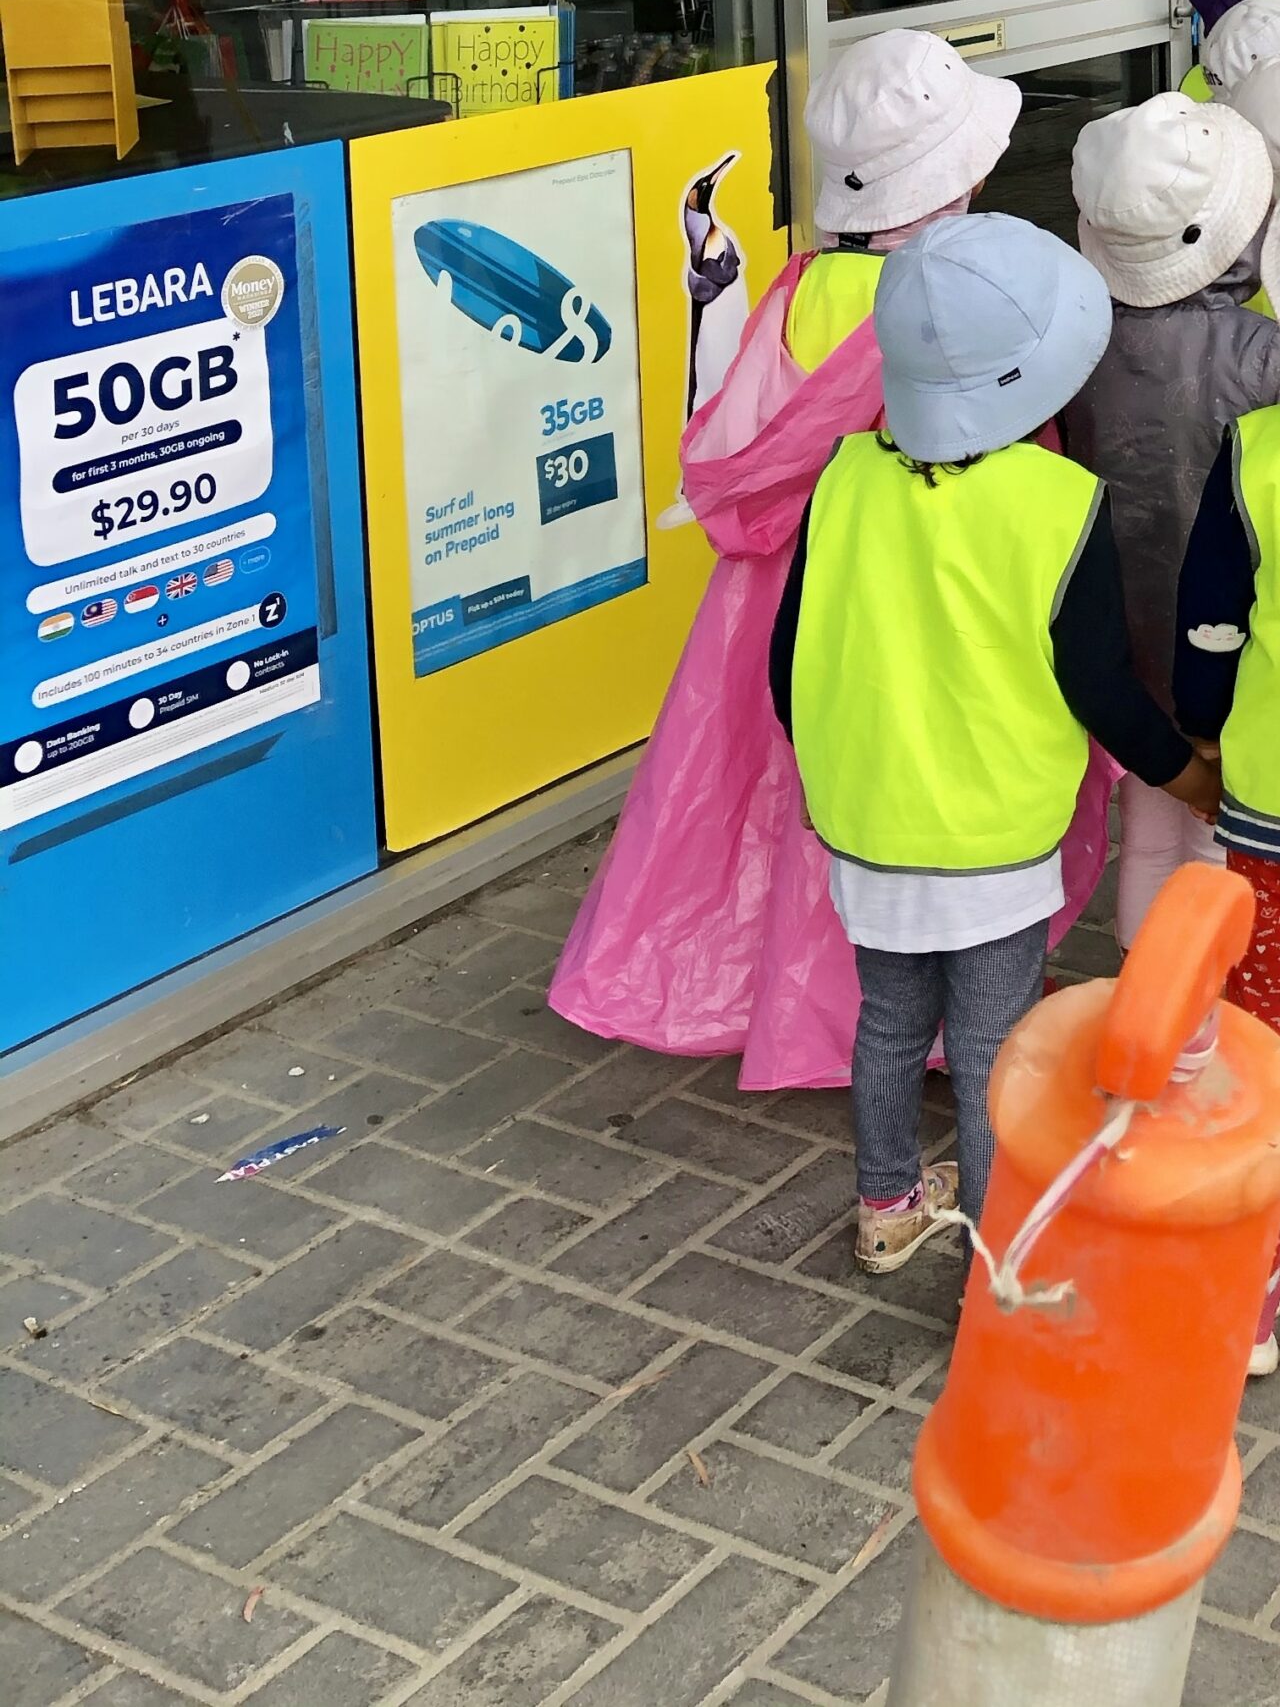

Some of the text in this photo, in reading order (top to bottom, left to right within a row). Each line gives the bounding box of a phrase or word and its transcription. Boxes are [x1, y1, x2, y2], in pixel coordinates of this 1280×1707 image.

[457, 33, 545, 70] Happy
[70, 261, 214, 328] LEBARA
[231, 276, 275, 297] Money
[53, 344, 239, 440] 50GB
[121, 419, 181, 445] per 30 days
[540, 397, 604, 436] 35GB
[72, 430, 226, 483] for first 3 months, 30GB ongoing
[544, 449, 589, 488] $30
[91, 472, 217, 541] $29.90
[425, 490, 474, 524] Surf all
[425, 500, 515, 544] summer long
[65, 529, 246, 595] Unlimited talk and text to 30 countries
[425, 524, 500, 566] on Prepaid
[412, 609, 455, 637] OPTUS
[38, 613, 256, 701] Includes 100 minutes to 34 countries in Zone 1
[253, 649, 289, 669] No Lock-in
[254, 660, 285, 678] contracts
[160, 693, 199, 715] Prepaid SIM
[170, 690, 183, 703] Day
[46, 722, 101, 749] Data Banking
[47, 746, 58, 760] up
[69, 734, 95, 752] 200GB
